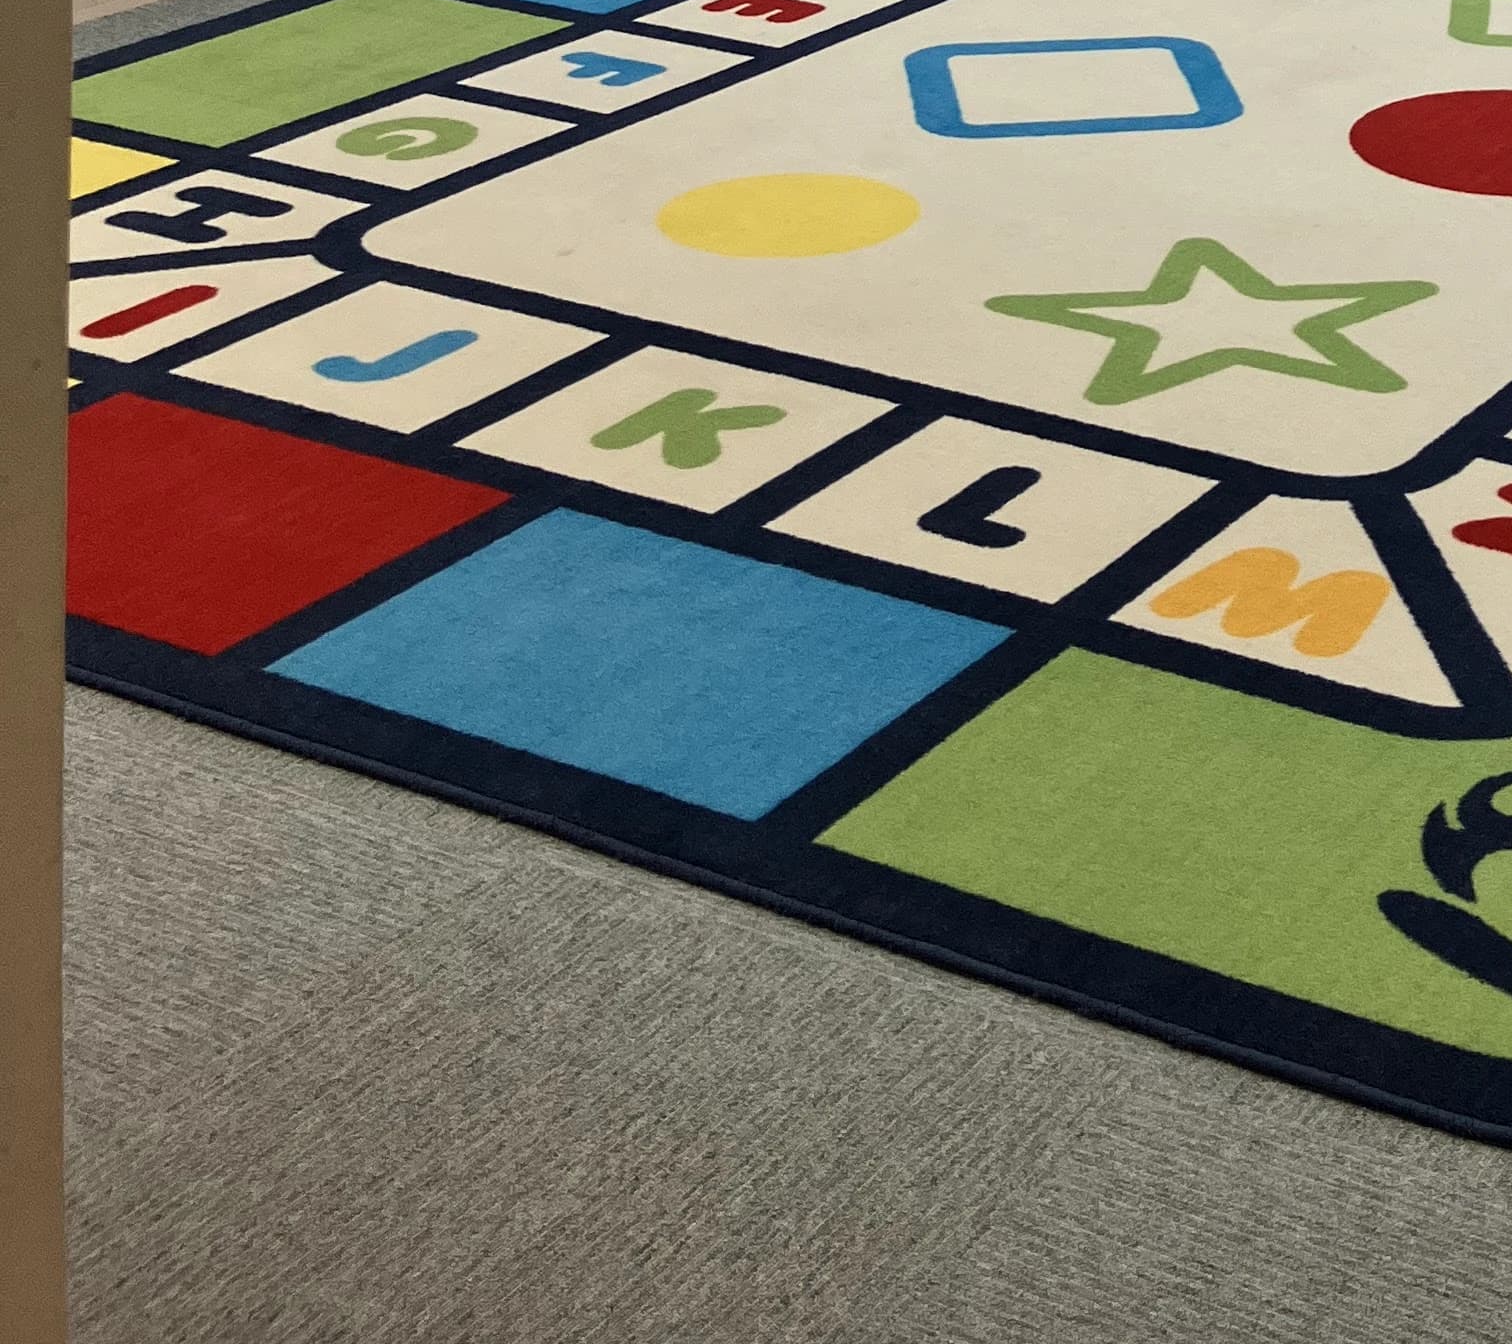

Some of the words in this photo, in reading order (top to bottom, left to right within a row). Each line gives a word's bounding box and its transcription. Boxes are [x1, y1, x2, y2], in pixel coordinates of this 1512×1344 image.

[560, 50, 668, 87] F
[334, 116, 480, 161] G
[104, 186, 294, 244] H
[80, 284, 218, 339] I
[311, 329, 479, 383] J
[590, 387, 788, 469] K
[917, 466, 1042, 549] L
[1148, 547, 1391, 659] M
